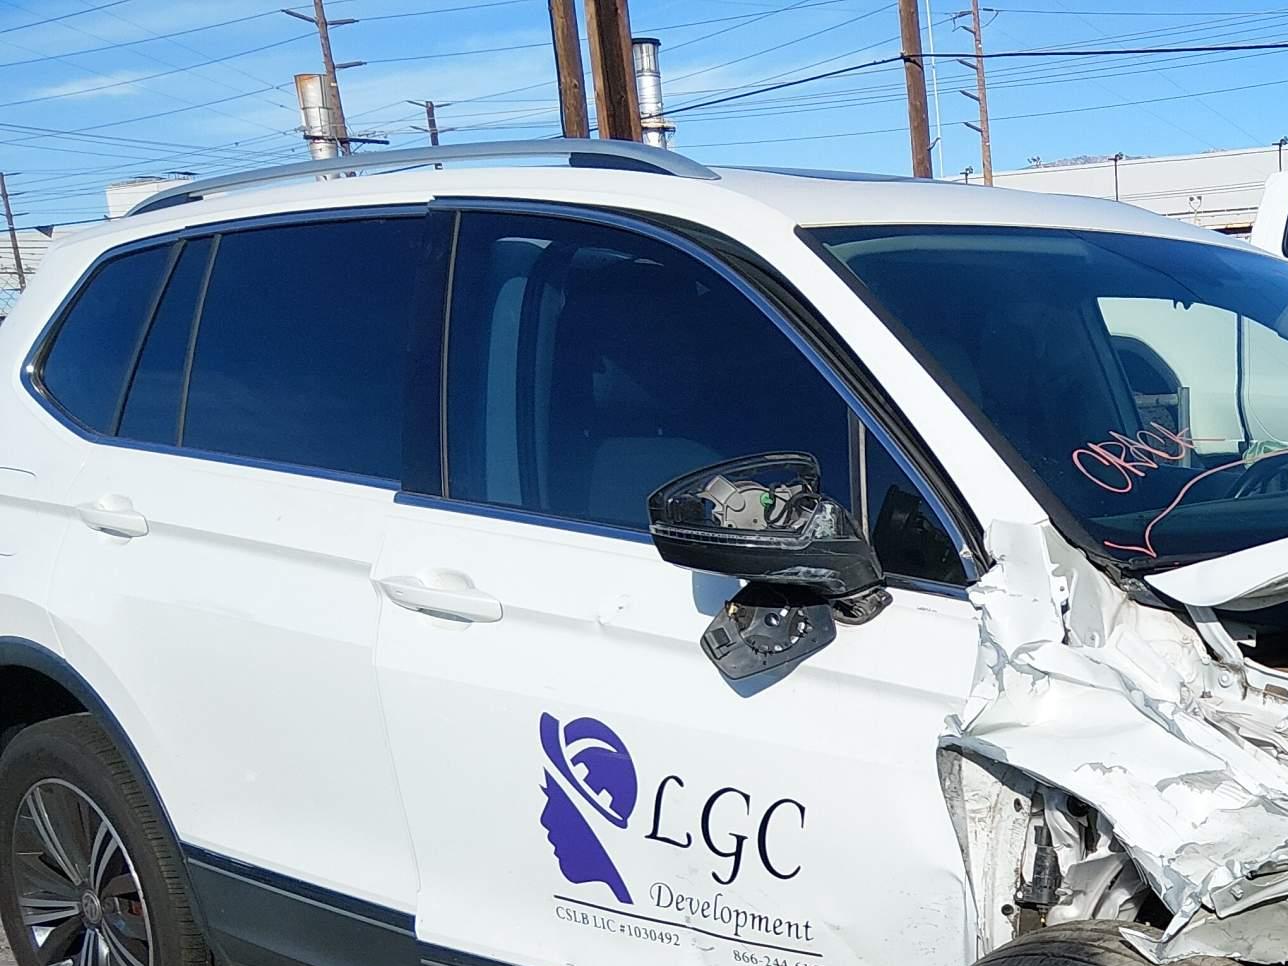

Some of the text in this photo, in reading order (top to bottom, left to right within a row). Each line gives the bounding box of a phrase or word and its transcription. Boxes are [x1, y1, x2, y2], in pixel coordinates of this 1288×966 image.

[644, 775, 806, 886] LGC
[555, 906, 681, 947] CSLB LIC #1030492
[649, 882, 814, 942] Development
